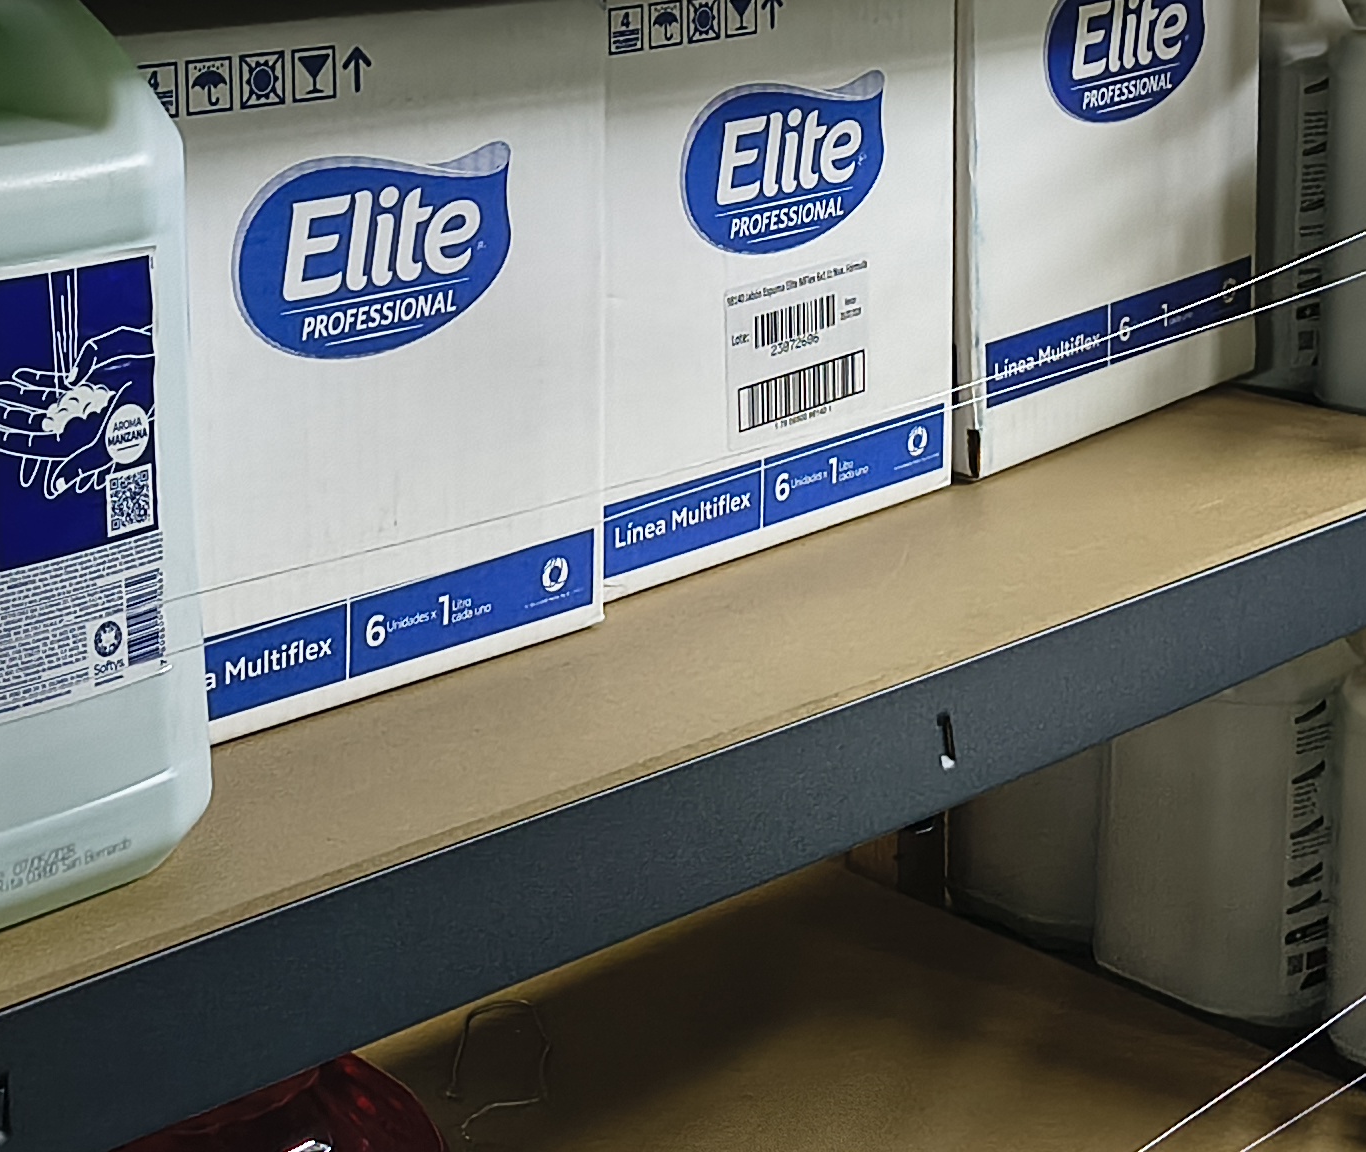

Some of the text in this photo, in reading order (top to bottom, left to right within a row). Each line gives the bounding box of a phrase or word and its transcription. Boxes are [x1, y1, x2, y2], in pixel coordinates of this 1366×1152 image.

[620, 12, 630, 29] 4
[148, 70, 161, 90] 4
[1082, 71, 1173, 111] PROFESSIONAL
[716, 107, 864, 206] Elite
[729, 195, 845, 240] PROFESSIONAL
[283, 185, 482, 302] Elite
[301, 288, 457, 341] PROFESSIONAL
[994, 354, 1035, 381] Línea
[1038, 332, 1102, 364] Multiflex
[1119, 316, 1131, 342] 6
[108, 427, 148, 448] MANZANA
[113, 416, 142, 432] AROMA
[614, 518, 667, 549] Línea
[671, 491, 752, 532] Multiflex
[774, 472, 790, 501] 6
[828, 456, 838, 484] 1
[451, 601, 492, 624] cada uno
[224, 635, 333, 686] Multiflex
[365, 613, 387, 648] 6
[386, 611, 428, 633] Unidades
[438, 594, 451, 626] 1
